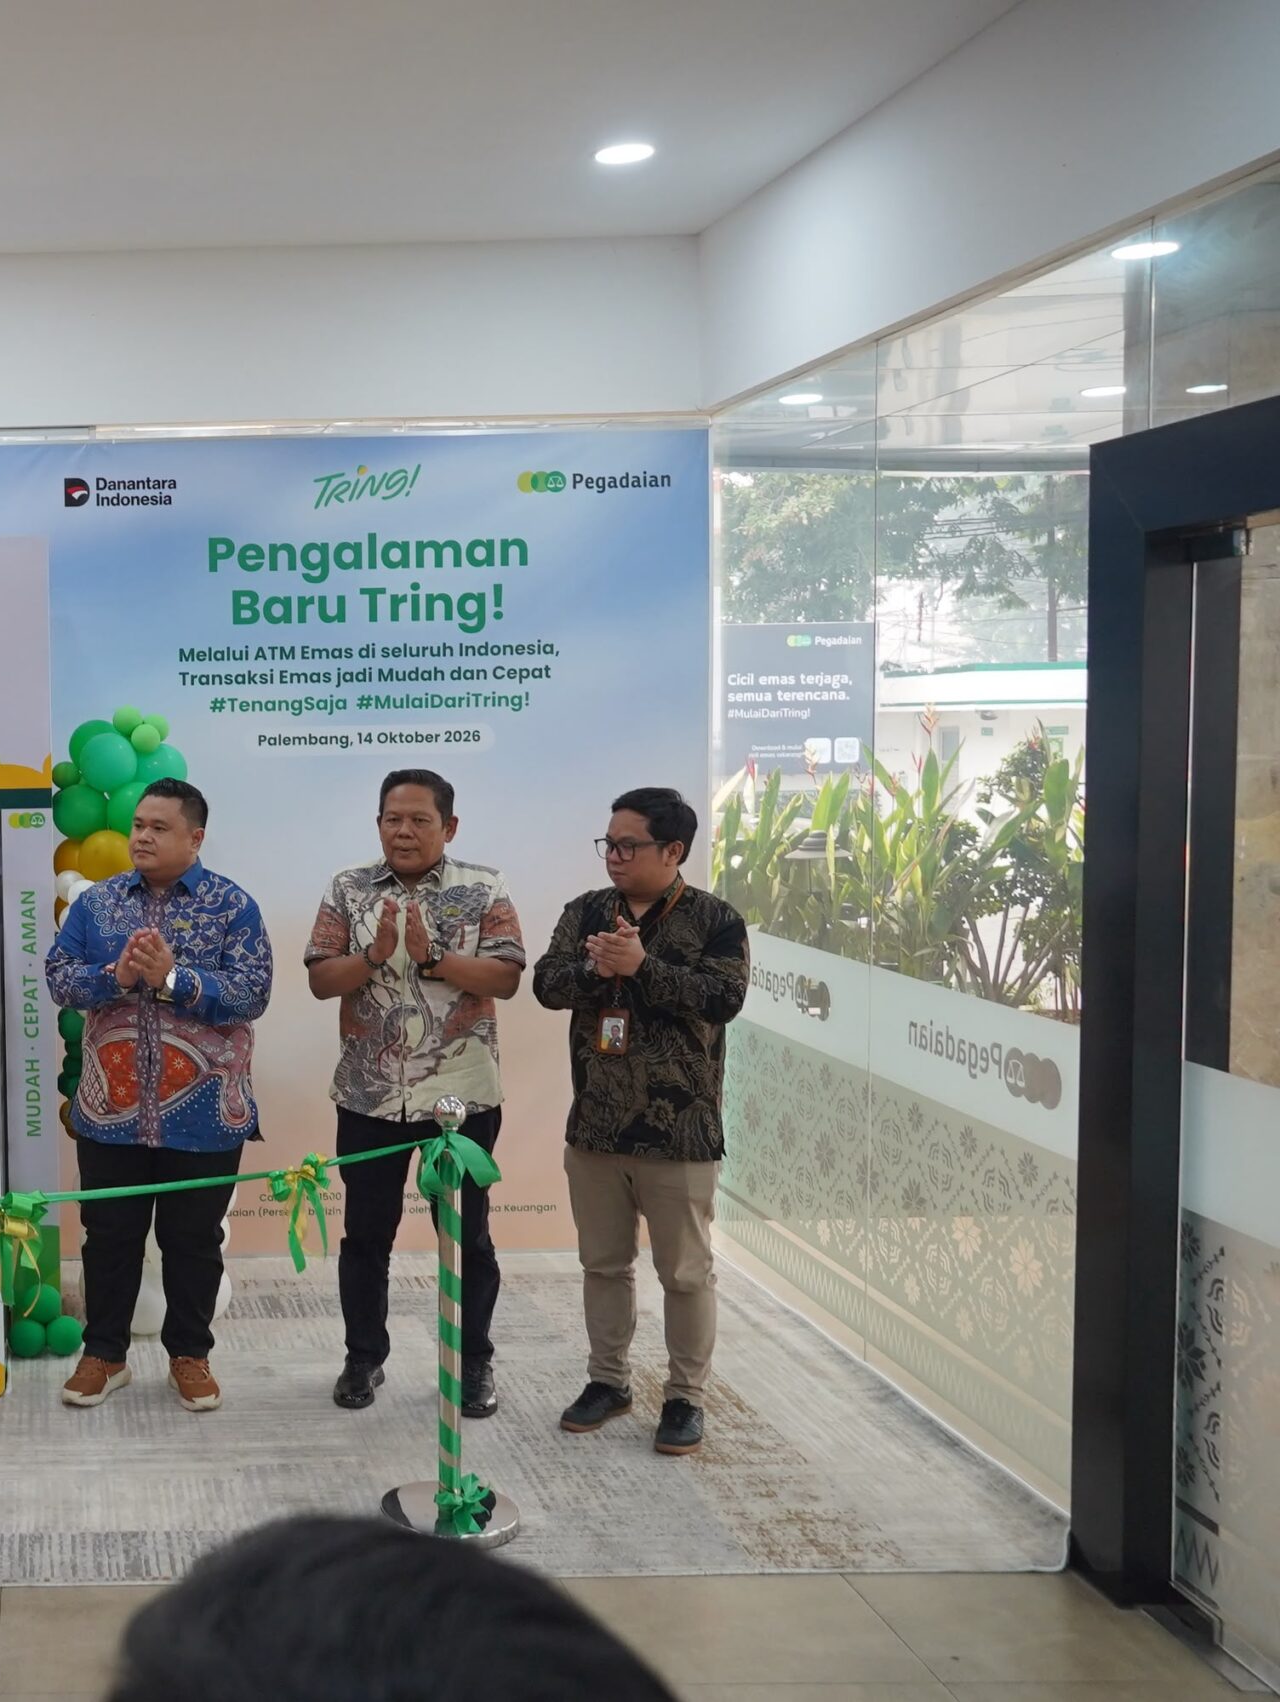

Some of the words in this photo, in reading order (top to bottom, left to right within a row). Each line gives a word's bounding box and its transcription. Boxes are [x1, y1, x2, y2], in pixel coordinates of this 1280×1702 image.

[96, 476, 177, 491] Danantara
[572, 471, 671, 493] Pegadaian
[96, 492, 172, 506] Indonesia
[208, 532, 528, 584] Pengalaman
[232, 590, 346, 625] Baru
[359, 582, 504, 634] Tring!
[179, 645, 249, 662] Melalui
[254, 646, 296, 661] ATM
[301, 645, 353, 660] Emas
[358, 643, 376, 659] di
[381, 642, 453, 658] seluruh
[459, 639, 560, 657] Indonesia,
[815, 636, 862, 647] Pegadaian
[179, 669, 274, 686] Transaksi
[279, 670, 332, 684] Emas
[336, 667, 372, 688] jadi
[378, 667, 445, 682] Mudah
[450, 666, 487, 681] dan
[492, 665, 551, 684] Cepat
[727, 673, 754, 685] Cicil
[759, 674, 795, 685] emas
[800, 672, 852, 688] terjaga,
[210, 695, 347, 716] #TenangSaja
[356, 691, 529, 712] #MulaiDariTring!
[727, 692, 772, 702] semua
[777, 690, 850, 701] terencana.
[258, 733, 353, 749] Palembang,
[357, 731, 373, 744] 14
[377, 731, 440, 744] Oktober
[444, 730, 481, 743] 2026
[21, 891, 37, 955] AMAN
[23, 975, 39, 1038] CEPAT
[25, 1059, 41, 1136] MUDAH
[504, 1203, 557, 1214] Keuangan
